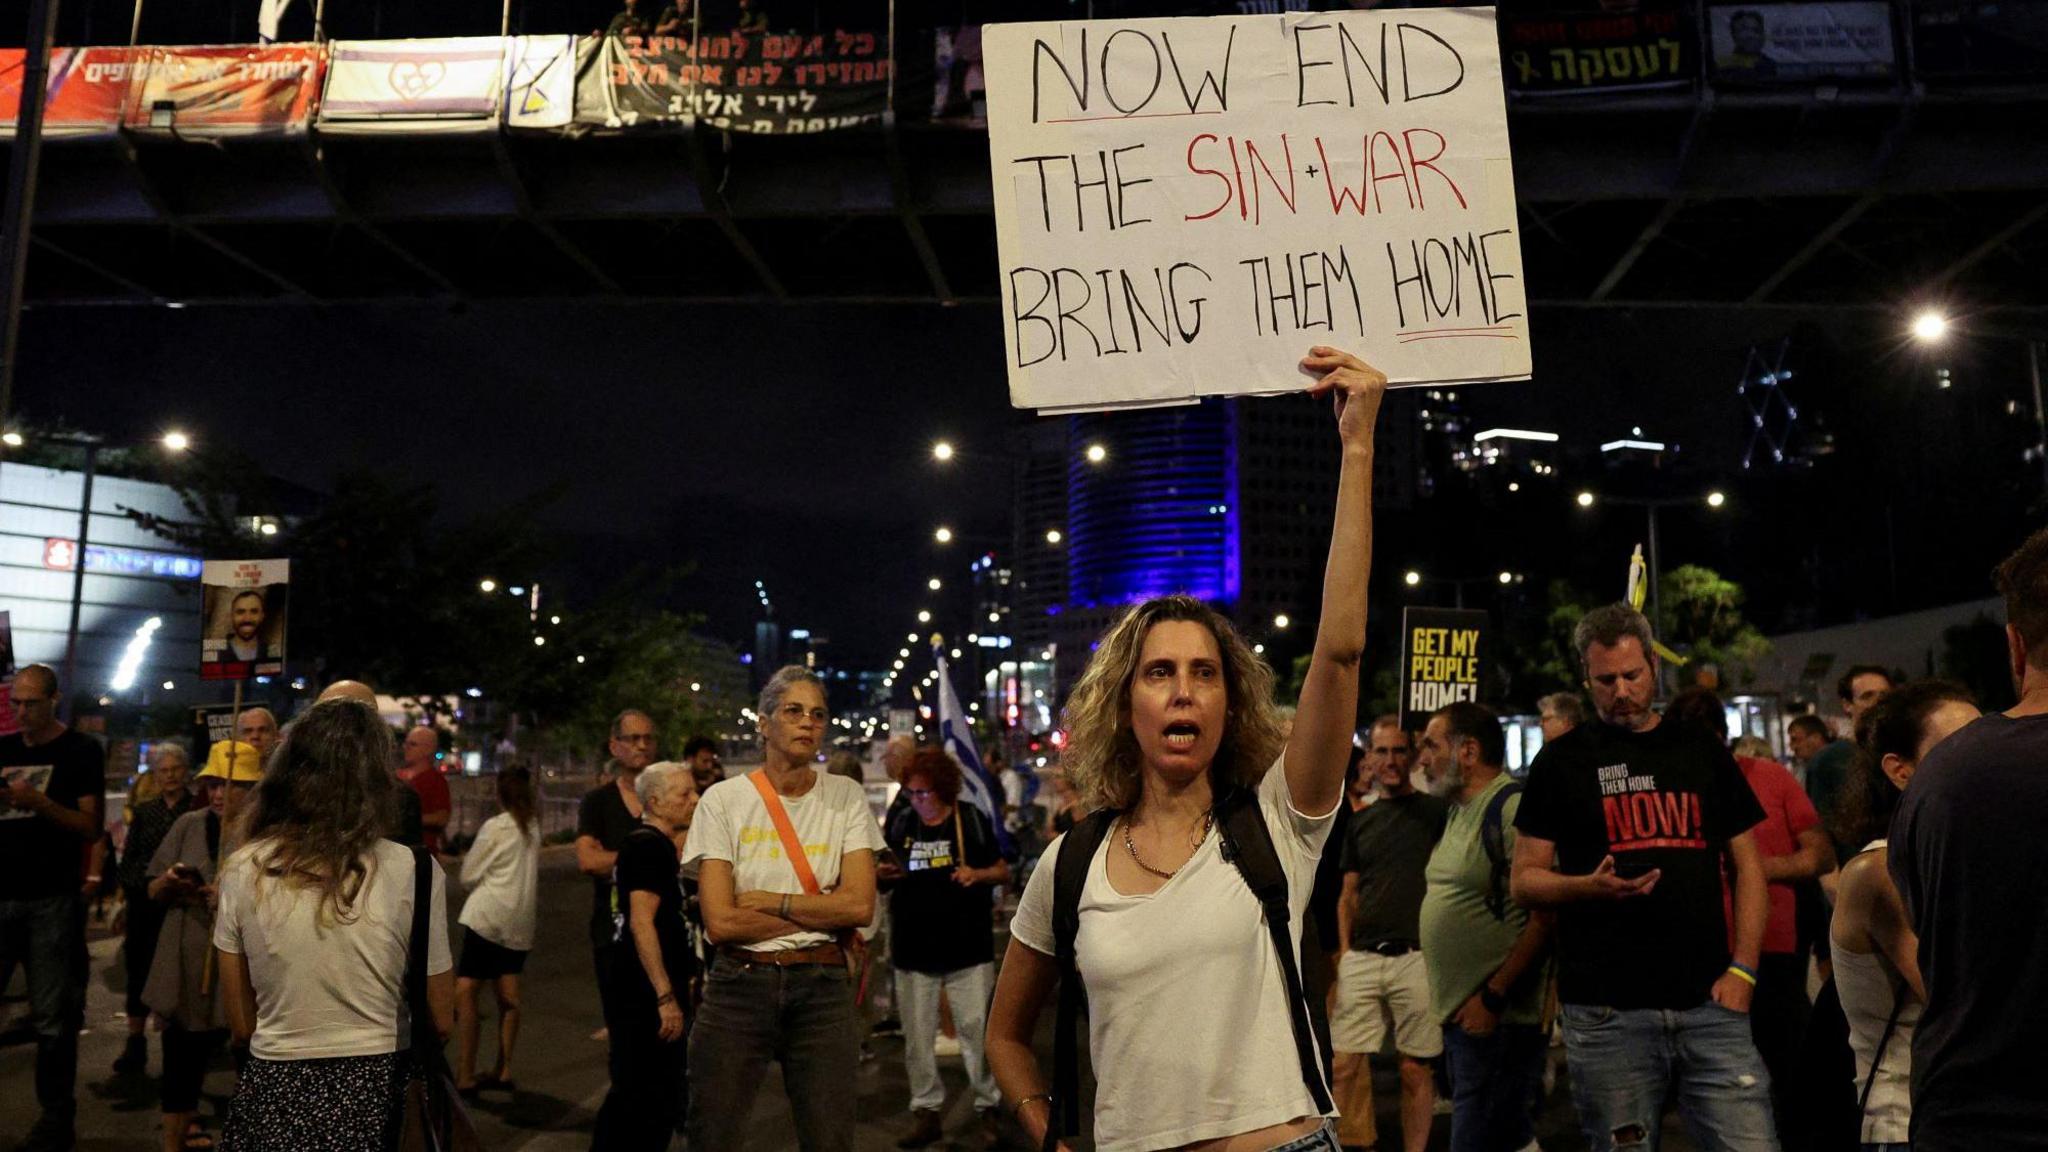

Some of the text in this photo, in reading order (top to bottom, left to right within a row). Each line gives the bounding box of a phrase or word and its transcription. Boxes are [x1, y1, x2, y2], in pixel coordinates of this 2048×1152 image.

[834, 28, 876, 56] כל
[679, 64, 723, 86] את
[736, 61, 783, 87] לנו
[1032, 22, 1465, 124] NOW END
[1549, 37, 1681, 86] לעסקה
[757, 88, 817, 114] לירי
[1012, 144, 1153, 232] THE
[1010, 229, 1522, 368] BRING THEM HOME
[1412, 627, 1480, 657] GET MY
[1410, 655, 1479, 682] PEOPLE
[1597, 763, 1629, 782] BRING
[1599, 775, 1657, 796] THEM HOME
[1602, 790, 1702, 843] NOW!
